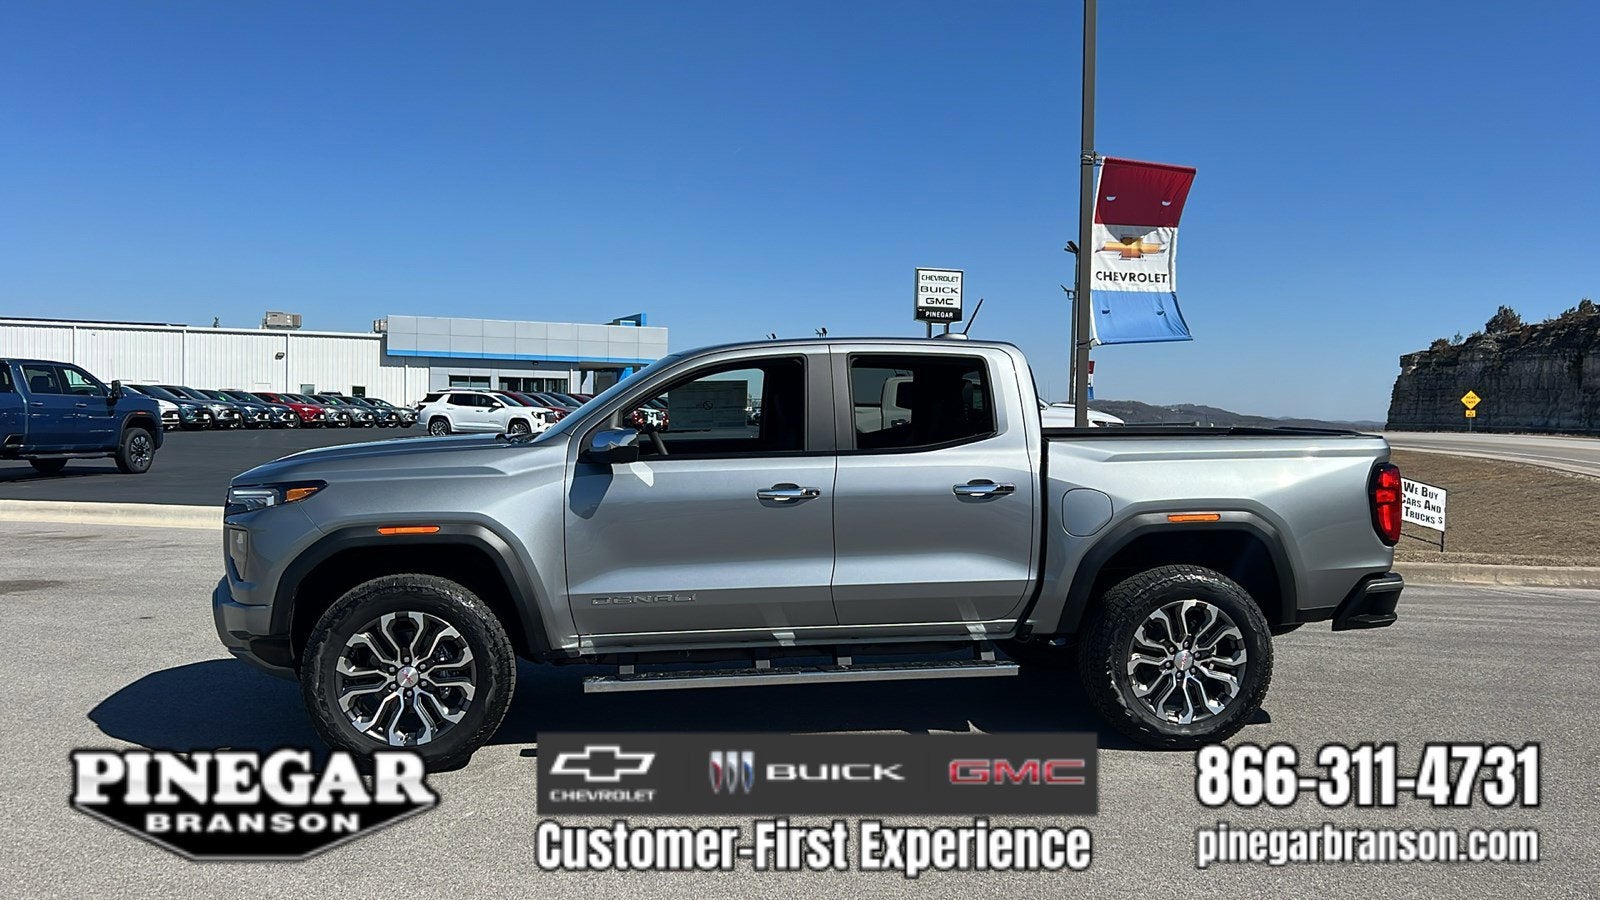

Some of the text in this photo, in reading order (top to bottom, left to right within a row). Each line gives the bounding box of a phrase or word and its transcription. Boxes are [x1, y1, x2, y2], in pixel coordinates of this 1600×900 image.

[921, 274, 959, 282] CHEVROLET
[1095, 270, 1168, 283] CHEVROLET
[920, 285, 959, 294] BUICK
[925, 297, 954, 306] GMC
[925, 310, 954, 319] PINEGAR
[592, 593, 697, 605] DENALI
